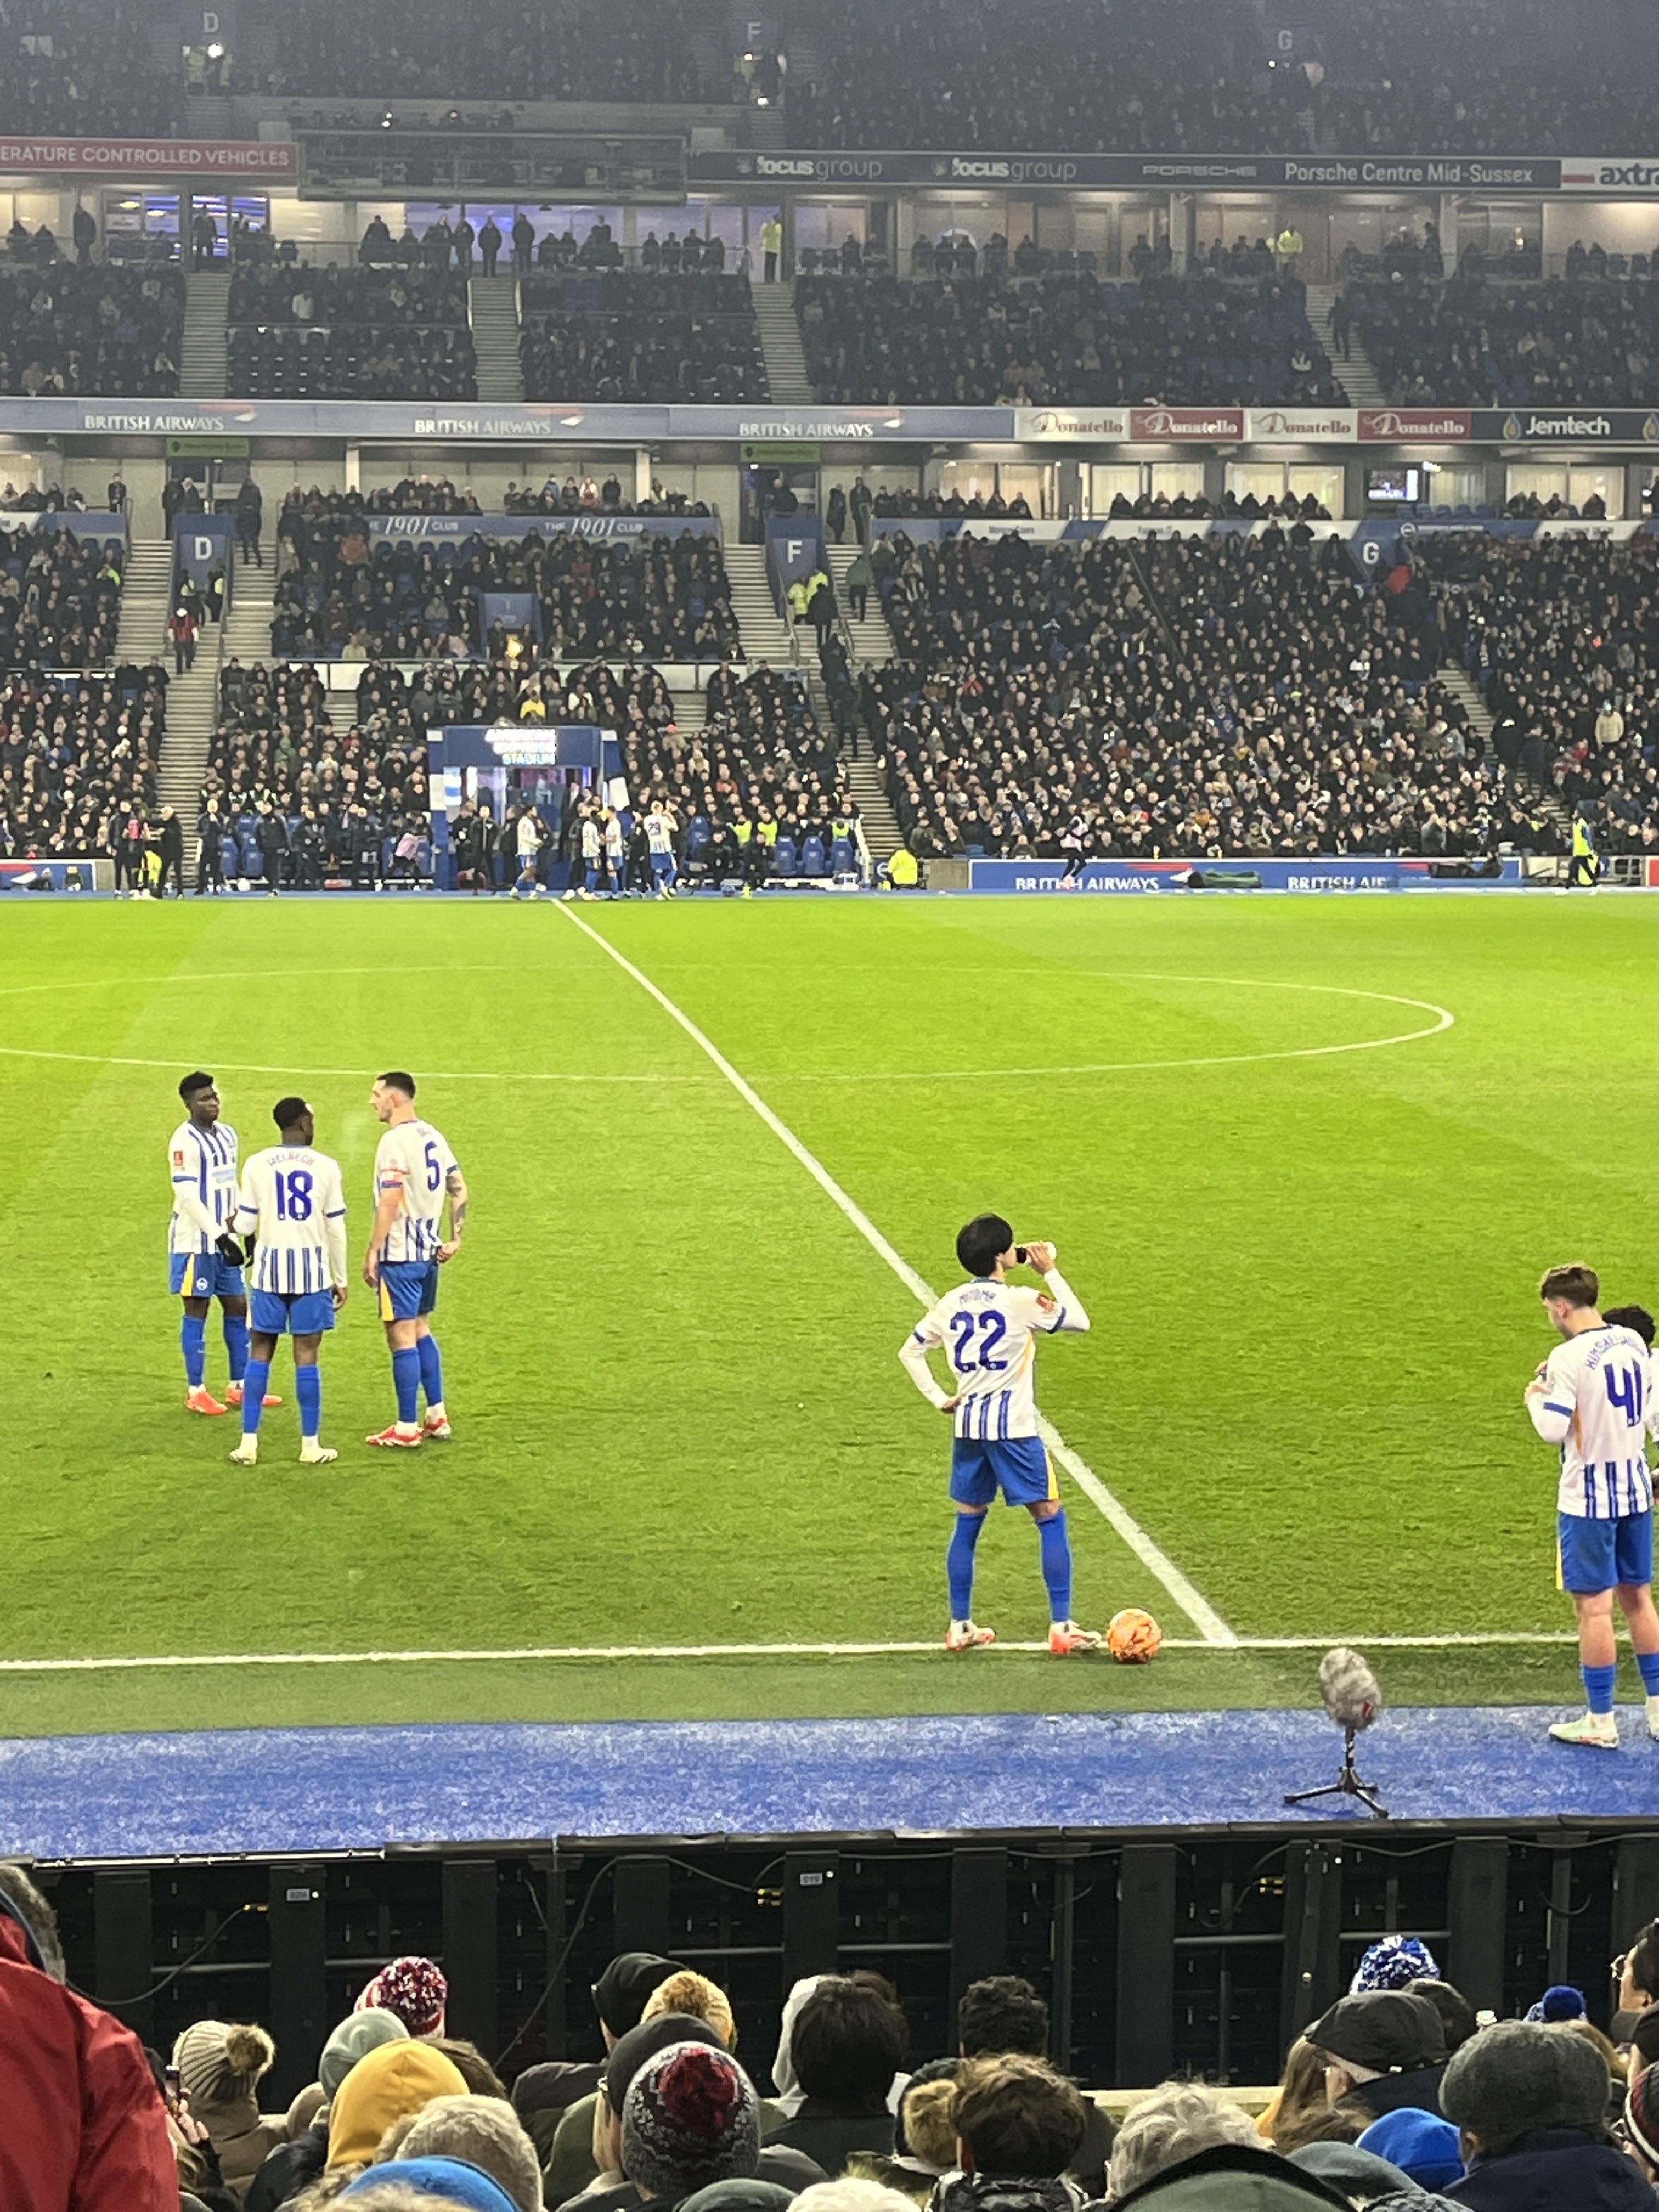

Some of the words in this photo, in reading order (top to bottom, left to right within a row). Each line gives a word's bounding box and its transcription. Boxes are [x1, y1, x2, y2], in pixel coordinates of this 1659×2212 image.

[202, 12, 219, 32] D
[747, 22, 761, 42] F
[1278, 30, 1293, 50] G
[0, 145, 77, 161] ERATURE
[82, 146, 202, 164] CONTROLLED
[205, 150, 289, 165] VEHICLES
[1143, 166, 1257, 176] PORSCHE
[1285, 163, 1357, 181] Porsche
[1362, 163, 1423, 182] Centre
[1427, 163, 1533, 183] Mid-Sussex
[84, 415, 151, 430] BRITISH
[153, 416, 224, 431] AIRWAYS
[414, 419, 479, 433] BRITISH
[482, 420, 551, 435] AIRWAYS
[739, 422, 803, 436] BRITISH
[806, 423, 874, 437] AIRWAYS
[1025, 411, 1124, 433] Donatello
[1136, 412, 1238, 435] Donatello
[1251, 412, 1351, 435] Donatello
[1363, 413, 1465, 435] Donatello
[1526, 416, 1610, 435] Jemtech
[385, 516, 431, 535] 1901
[432, 521, 459, 531] CLUB
[570, 517, 616, 536] 1901
[617, 522, 644, 533] CLUB
[195, 537, 212, 560] D
[788, 540, 803, 563] F
[1363, 541, 1380, 565] G
[1086, 877, 1159, 890] AIRWAYS
[1288, 877, 1356, 890] BRITISH
[425, 1141, 441, 1192] 5
[275, 1170, 313, 1221] 18
[950, 1309, 1008, 1373] 22
[1603, 1357, 1643, 1428] 41
